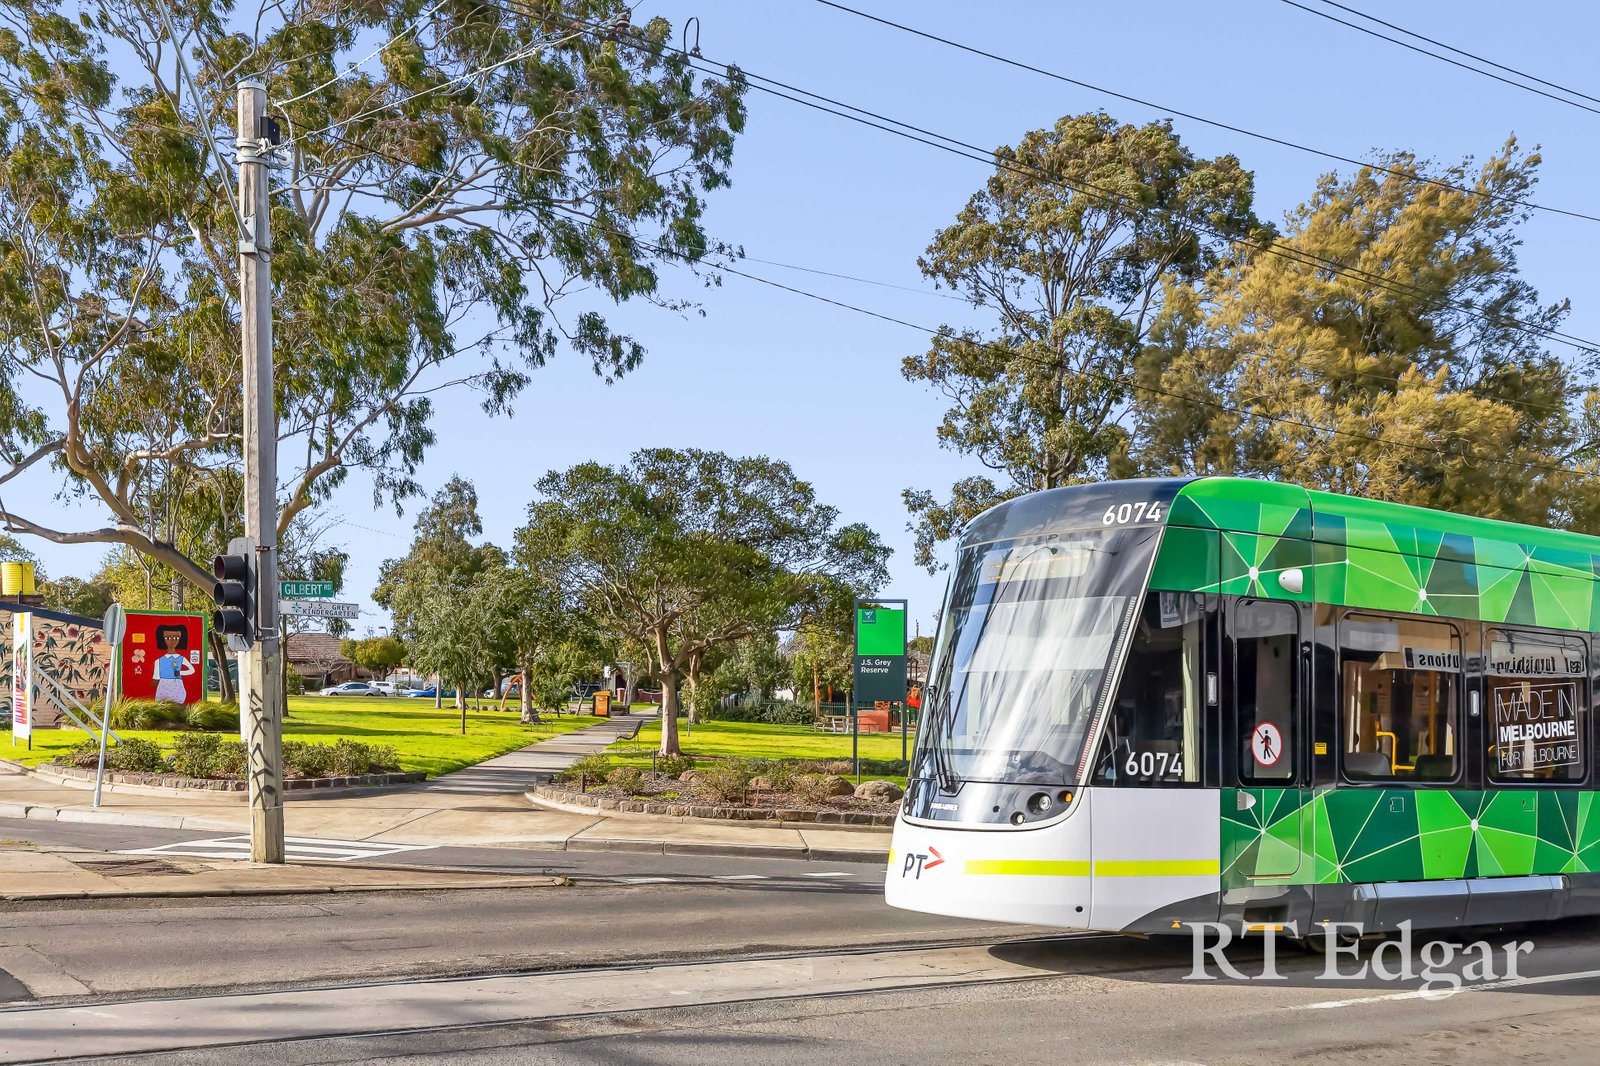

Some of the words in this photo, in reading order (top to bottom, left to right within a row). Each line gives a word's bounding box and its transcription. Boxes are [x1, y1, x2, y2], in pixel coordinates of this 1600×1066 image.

[1102, 500, 1162, 526] 6074
[284, 583, 323, 595] GILBERT
[302, 608, 356, 617] KINDERGARTEN
[860, 666, 889, 674] Reserve
[874, 659, 892, 668] Grey
[1498, 688, 1554, 722] MADE
[1557, 686, 1575, 717] IN
[1500, 720, 1576, 743] MELBOURNE
[1125, 751, 1183, 777] 6074
[1501, 750, 1520, 767] FOR
